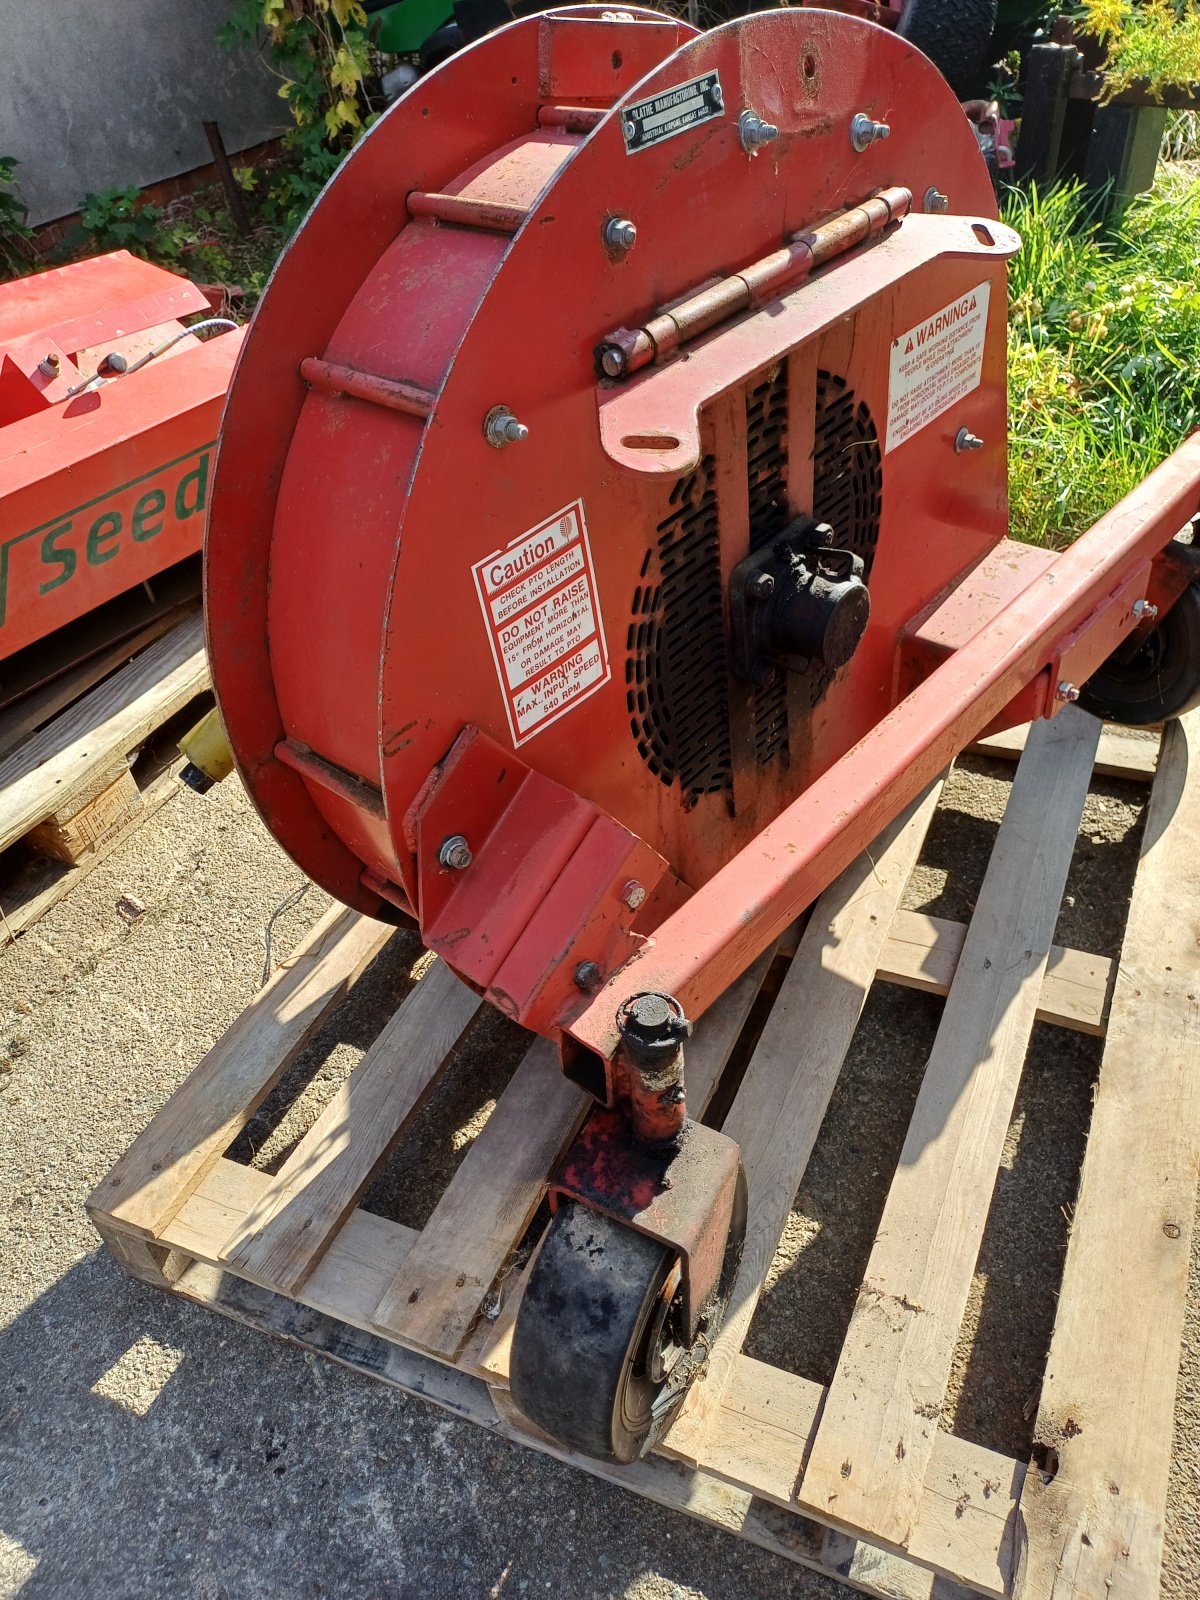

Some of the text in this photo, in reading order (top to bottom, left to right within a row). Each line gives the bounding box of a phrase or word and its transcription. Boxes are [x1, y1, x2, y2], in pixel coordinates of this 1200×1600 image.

[700, 80, 711, 93] INC.
[898, 361, 911, 374] KEEP
[916, 349, 927, 362] SAFE
[928, 335, 948, 353] WORKING
[949, 321, 968, 340] DISTANCE
[969, 313, 981, 326] FROM
[916, 299, 969, 347] WARNING
[905, 325, 974, 378] PEOPLE WHILE THIS ATTACHMENT
[891, 399, 899, 409] DO
[900, 392, 909, 404] NOT
[910, 382, 923, 396] RAISE
[924, 362, 950, 386] ATTACHMENT
[951, 353, 963, 367] MORE
[964, 345, 975, 358] THAN
[897, 399, 910, 413] FROM
[911, 381, 937, 403] HORIZONTAL
[938, 370, 950, 384] WHILE
[890, 407, 909, 426] DAMAGE
[910, 400, 919, 411] MAY
[920, 389, 935, 404] OCCUR
[910, 412, 921, 424] MUST
[490, 536, 555, 587] Caution
[500, 551, 575, 605] CHECK PTO LENGTH
[497, 559, 581, 619] BEFORE INSTALLATION
[502, 580, 586, 644] DO NOT RAISE
[503, 591, 589, 655] EQUIPMENT MORE THAN
[520, 622, 582, 669] OR DAMAGE MAY
[522, 636, 544, 655] FROM
[545, 605, 590, 639] HORIZONTAL
[525, 634, 581, 677] RESULT TO PTO
[531, 653, 584, 696] WARNING
[543, 676, 570, 699] INPUT
[573, 653, 600, 679] SPEED
[543, 681, 581, 713] 540 RPM
